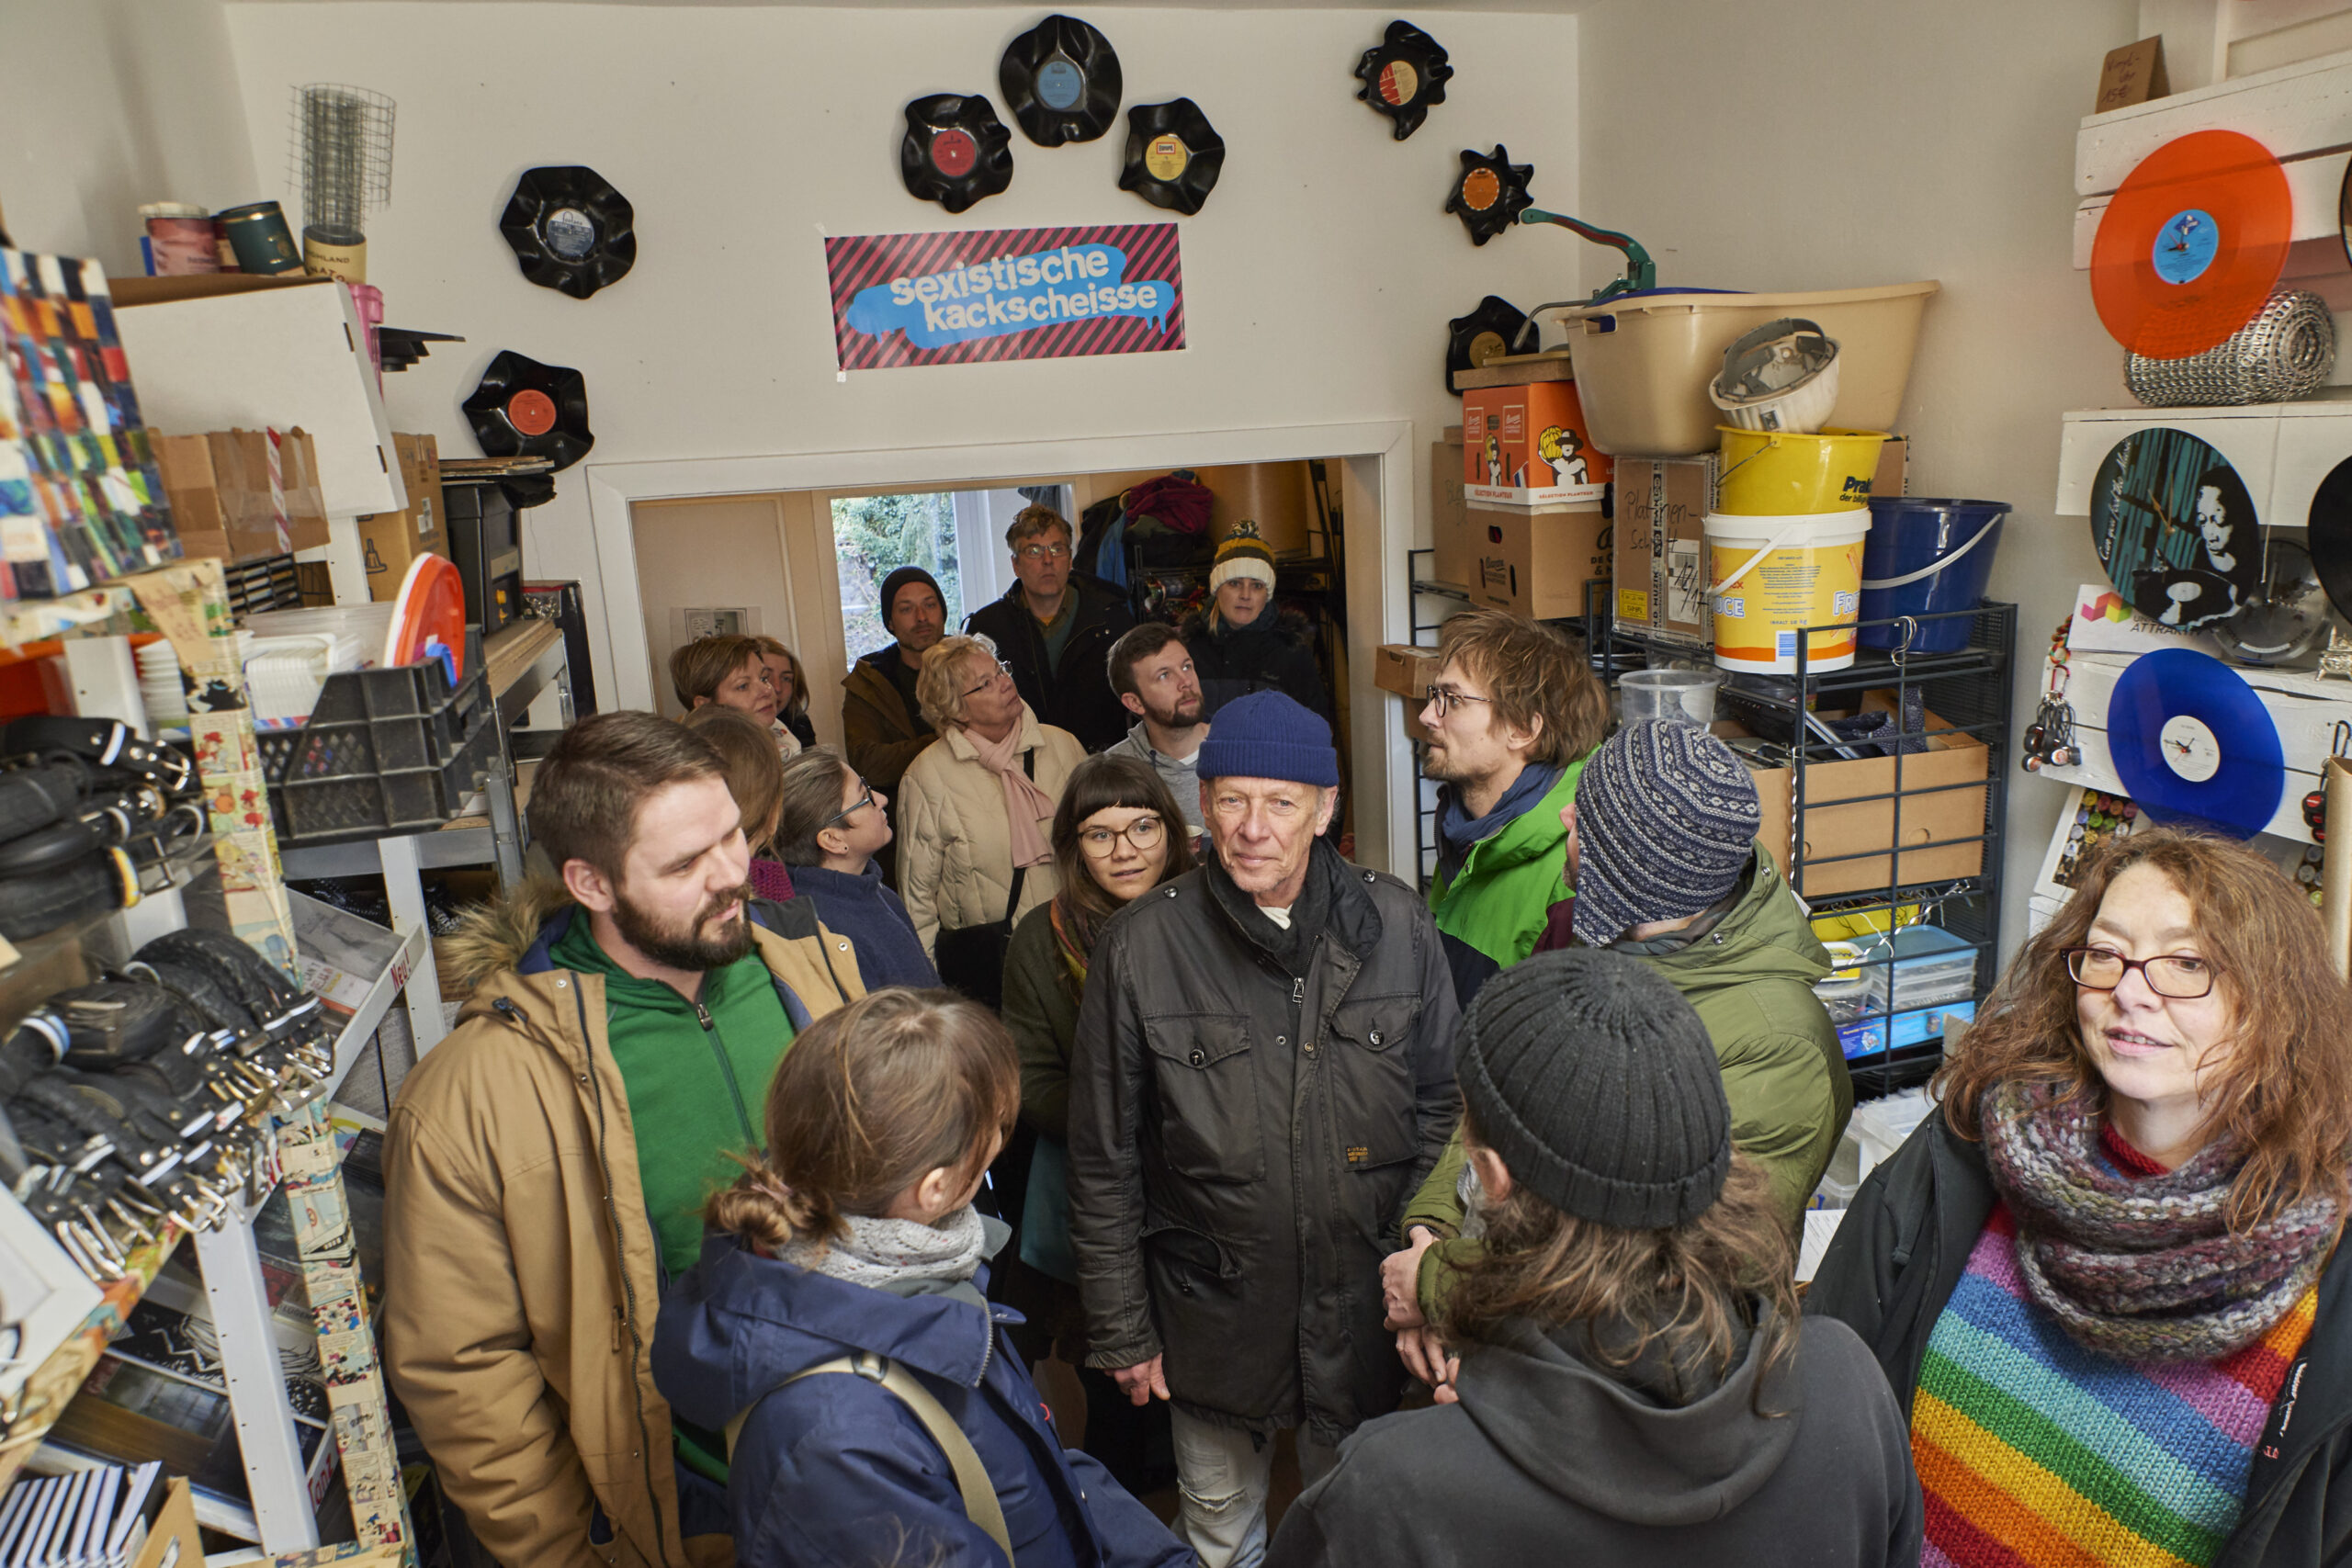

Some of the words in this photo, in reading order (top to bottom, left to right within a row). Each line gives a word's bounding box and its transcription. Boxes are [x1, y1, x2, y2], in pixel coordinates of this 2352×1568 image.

[889, 245, 1110, 306] sexistische
[923, 283, 1158, 333] kackscheisse
[1839, 493, 1852, 502] der
[390, 947, 412, 994] Neu!
